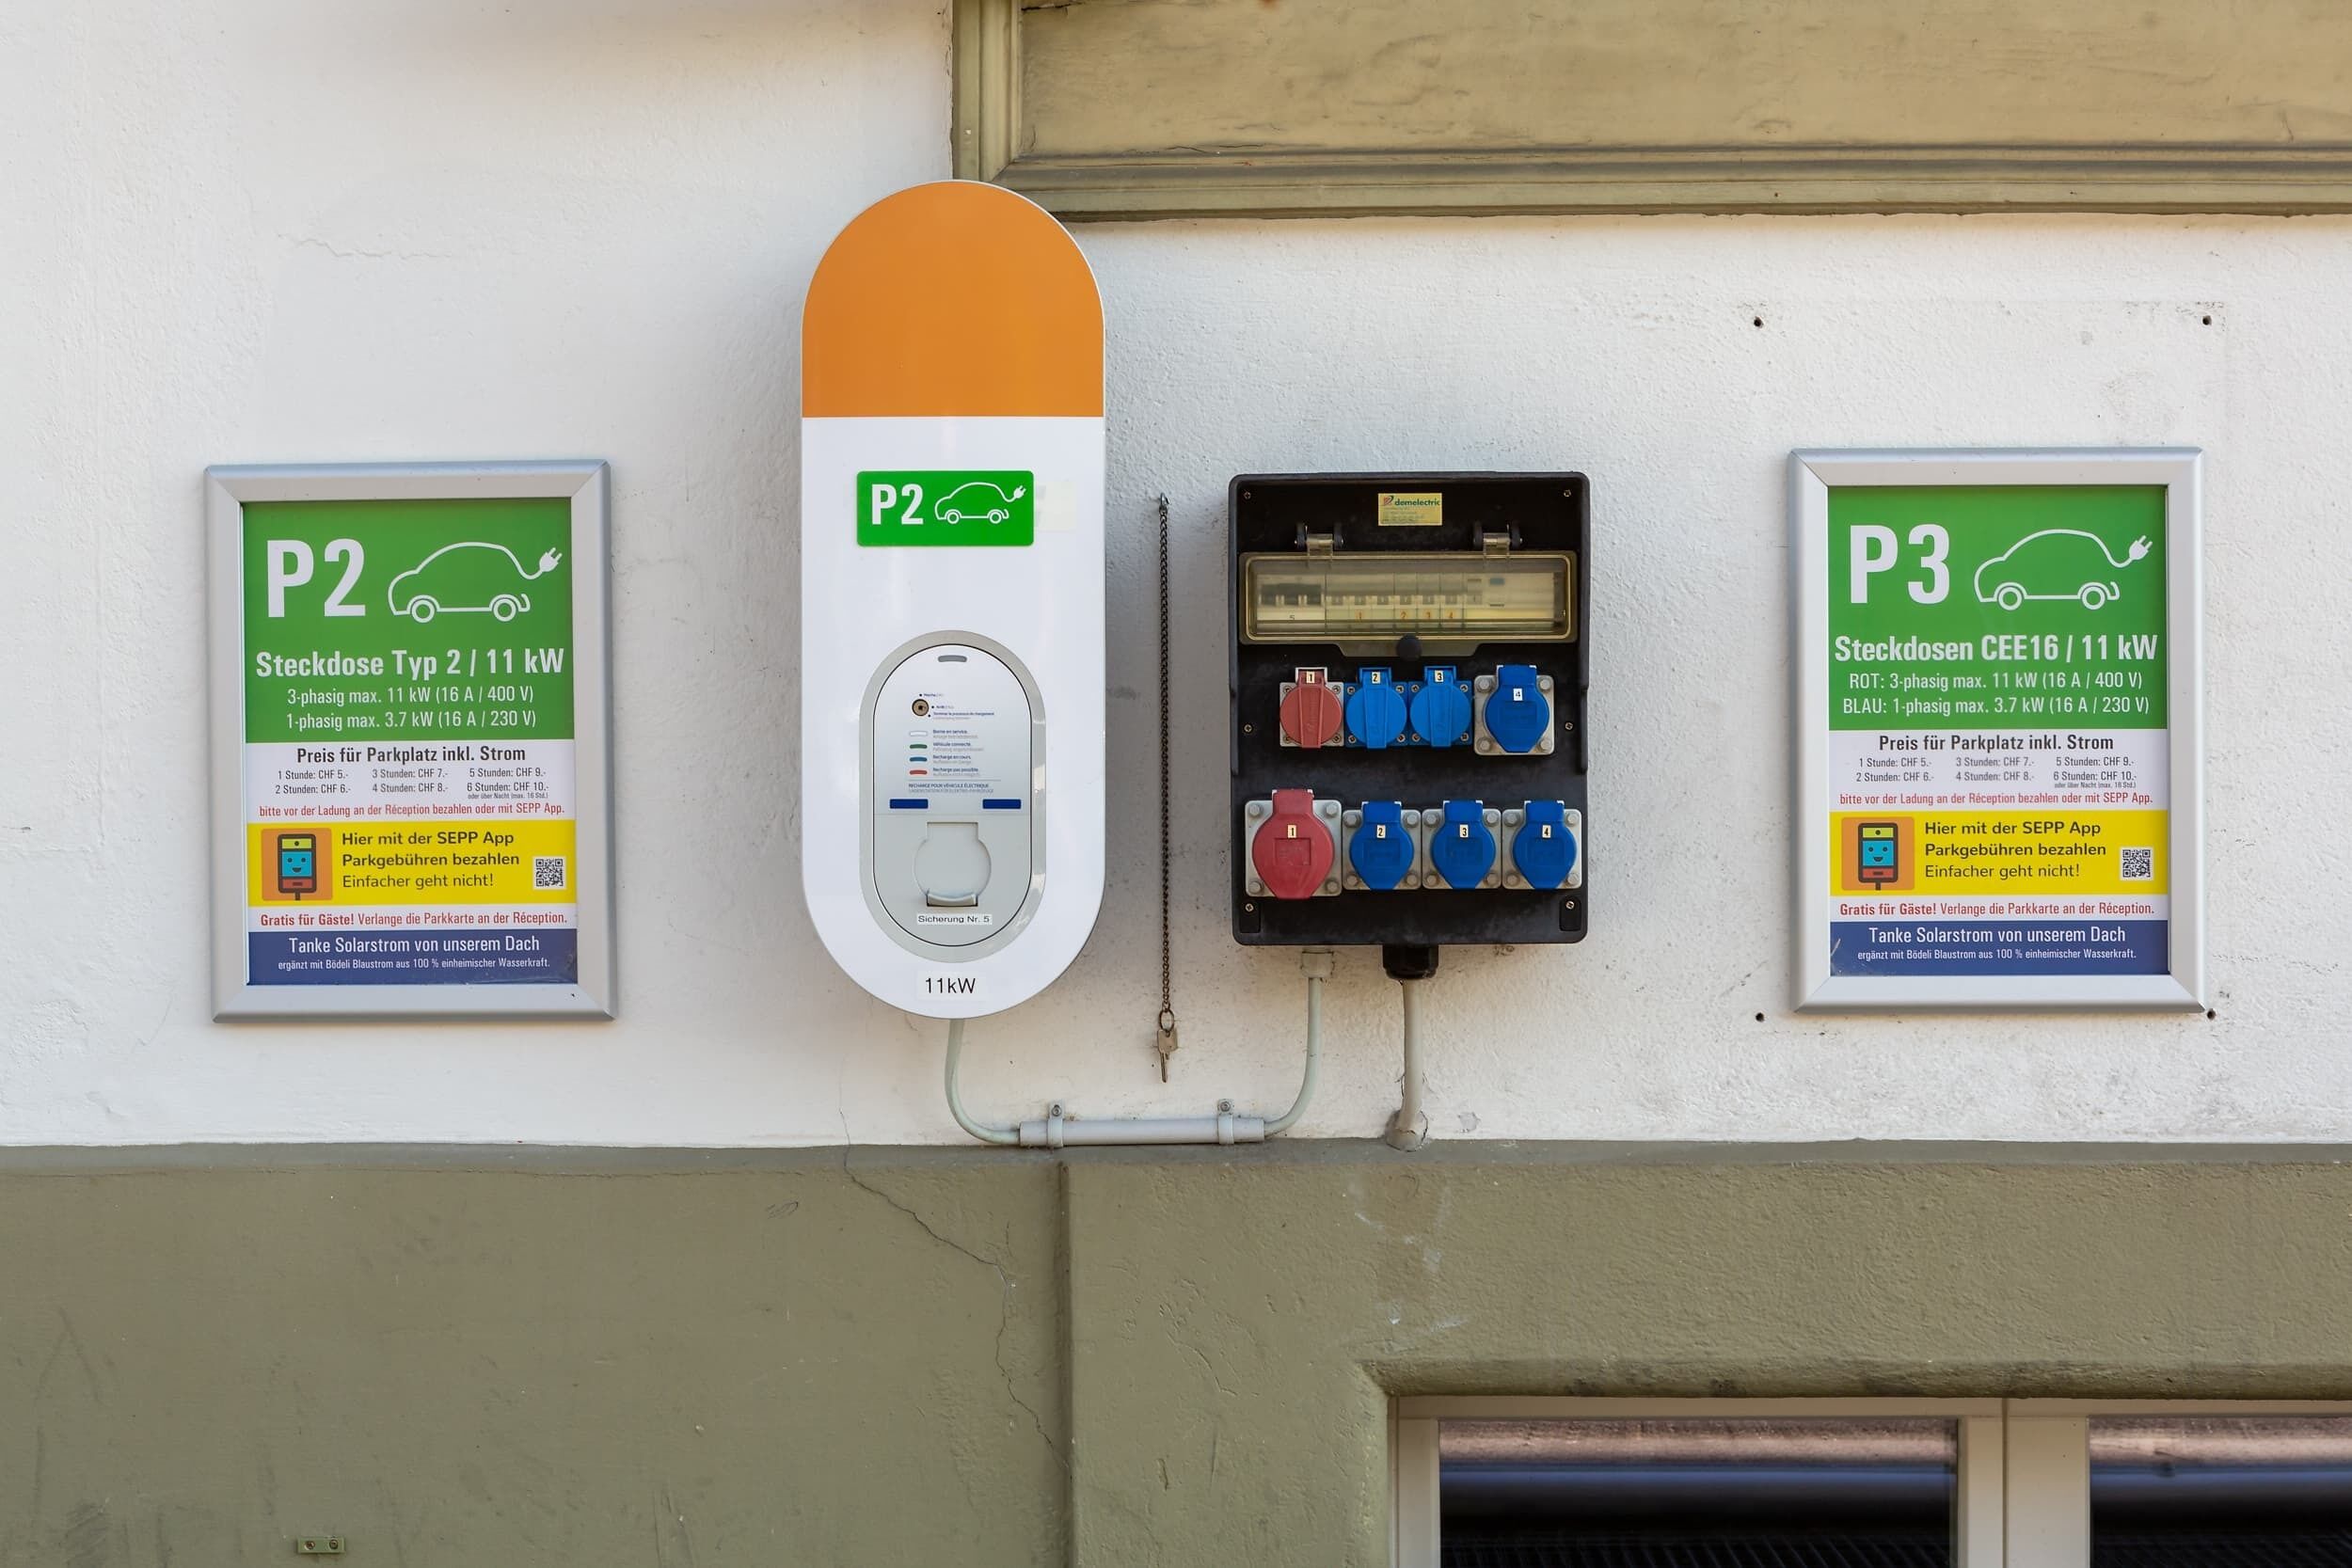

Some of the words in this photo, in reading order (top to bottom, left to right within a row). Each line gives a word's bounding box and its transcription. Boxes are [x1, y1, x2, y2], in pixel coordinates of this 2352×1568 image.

[871, 483, 924, 525] P2
[1394, 498, 1440, 506] demelectric
[1850, 524, 1950, 605] P3
[267, 538, 365, 618] P2
[1835, 635, 1973, 661] Steckdosen
[1981, 634, 2058, 660] CEE16
[2066, 635, 2073, 662] /
[2082, 635, 2106, 659] 11
[2118, 634, 2157, 659] kW
[256, 650, 383, 676] Steckdose
[391, 649, 437, 680] Typ
[447, 649, 460, 673] 2
[469, 649, 475, 676] /
[487, 648, 512, 673] 11
[525, 648, 564, 673] kW
[1309, 673, 1313, 682] 1
[1373, 673, 1378, 682] 2
[1437, 673, 1442, 682] 3
[1850, 673, 1883, 689] ROT:
[1889, 673, 1947, 691] 3-phasig
[1953, 676, 1986, 688] max.
[1993, 673, 2008, 688] 11
[2015, 672, 2037, 688] kW
[2042, 672, 2065, 689] (16
[2071, 672, 2080, 687] A
[2085, 672, 2090, 689] /
[2094, 672, 2122, 687] 400
[2128, 672, 2141, 689] V)
[288, 688, 343, 707] 3-phasig
[349, 691, 381, 703] max.
[388, 687, 402, 702] 11
[409, 687, 430, 702] kW
[436, 686, 458, 704] (16
[464, 686, 473, 701] A
[478, 687, 483, 702] /
[487, 686, 515, 701] 400
[519, 686, 532, 703] V)
[1516, 690, 1521, 699] 4
[1843, 698, 1886, 713] BLAU:
[1893, 697, 1949, 717] 1-phasig
[1955, 701, 1988, 712] max.
[1994, 697, 2016, 712] 3.7
[2023, 697, 2043, 712] kW
[2049, 696, 2072, 714] (16
[2078, 697, 2087, 712] A
[2092, 697, 2097, 713] /
[2103, 696, 2129, 712] 230
[2135, 696, 2148, 713] V)
[287, 712, 342, 732] 1-phasig
[347, 716, 379, 727] max.
[385, 711, 406, 727] 3.7
[412, 711, 433, 726] kW
[438, 710, 461, 728] (16
[467, 710, 476, 725] A
[480, 711, 485, 727] /
[490, 710, 516, 726] 230
[522, 710, 535, 727] V)
[1880, 735, 1917, 750] Preis
[1923, 735, 1945, 750] für
[1951, 735, 2023, 753] Parkplatz
[2029, 734, 2060, 749] inkl.
[2067, 734, 2113, 749] Strom
[297, 748, 334, 763] Preis
[340, 747, 361, 762] für
[367, 746, 437, 765] Parkplatz
[442, 746, 474, 761] inkl.
[480, 745, 525, 760] Strom
[278, 770, 282, 779] 1
[285, 769, 315, 779] Stunde:
[318, 769, 334, 779] CHF
[337, 768, 347, 779] 5.-
[371, 768, 377, 778] 3
[380, 768, 415, 778] Stunden:
[418, 768, 434, 778] CHF
[437, 768, 447, 777] 7.-
[469, 768, 474, 777] 5
[477, 767, 513, 777] Stunden:
[516, 767, 532, 776] CHF
[534, 767, 545, 776] 9.-
[274, 784, 280, 794] 2
[283, 784, 318, 794] Stunden:
[321, 784, 337, 793] CHF
[340, 784, 350, 793] 6.-
[371, 784, 377, 792] 4
[380, 783, 415, 792] Stunden:
[418, 783, 434, 792] CHF
[437, 783, 447, 791] 8.-
[466, 782, 472, 791] 6
[474, 782, 510, 793] Stunden:
[514, 782, 530, 793] CHF
[533, 781, 548, 793] 10.-
[1840, 794, 1861, 804] bitte
[1883, 793, 1897, 803] der
[1900, 793, 1932, 805] Ladung
[1950, 793, 1965, 803] der
[1969, 792, 2014, 805] Réception
[2018, 792, 2058, 802] bezahlen
[2061, 792, 2081, 802] oder
[2085, 792, 2100, 802] mit
[2103, 792, 2128, 802] SEPP
[2131, 792, 2153, 805] App.
[342, 832, 373, 845] Hier
[378, 832, 403, 844] mit
[407, 832, 432, 844] der
[437, 831, 478, 844] SEPP
[483, 831, 514, 845] App
[1290, 827, 1295, 836] 1
[1378, 827, 1384, 836] 2
[1462, 827, 1468, 836] 3
[1544, 827, 1549, 836] 4
[342, 853, 447, 869] Parkgebühren
[453, 852, 518, 865] bezahlen
[342, 874, 409, 887] Einfacher
[415, 874, 447, 890] geht
[453, 873, 492, 886] nicht!
[261, 913, 294, 926] Gratis
[298, 913, 314, 925] für
[319, 913, 354, 925] Gäste!
[358, 912, 402, 927] Verlange
[405, 912, 420, 924] die
[424, 911, 473, 924] Parkkarte
[477, 914, 489, 923] an
[493, 911, 509, 923] der
[513, 911, 566, 926] Réception.
[917, 914, 964, 924] Sicherung
[967, 915, 980, 924] Nr.
[289, 937, 330, 953] Tanke
[335, 937, 409, 952] Solarstrom
[414, 940, 437, 951] von
[443, 940, 500, 951] unserem
[505, 935, 539, 950] Dach
[926, 977, 976, 994] 11kW
